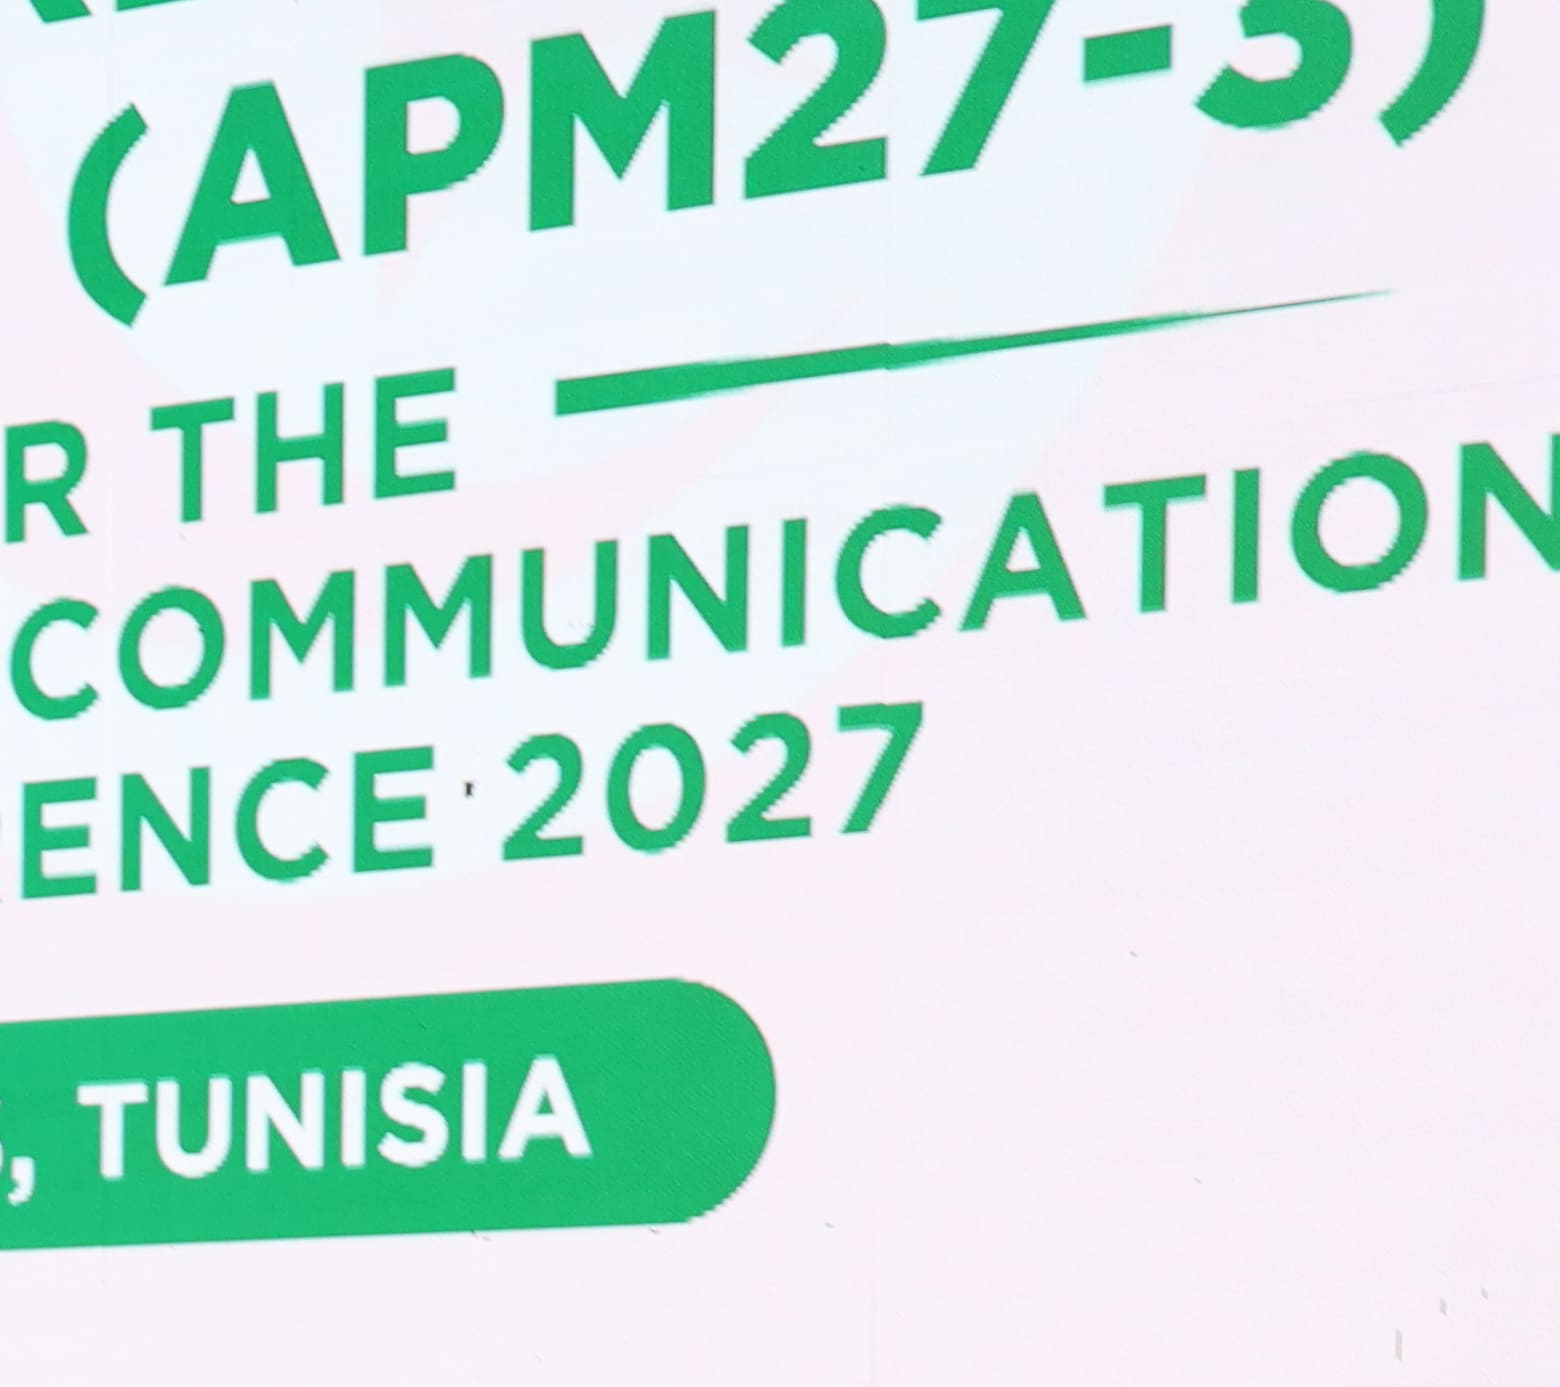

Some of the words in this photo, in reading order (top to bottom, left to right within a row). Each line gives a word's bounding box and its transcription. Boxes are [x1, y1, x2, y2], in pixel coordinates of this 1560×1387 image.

[63, 0, 1486, 330] (APM27-3)
[147, 366, 457, 525] THE
[498, 702, 924, 864] 2027
[76, 1057, 593, 1179] TUNISIA
